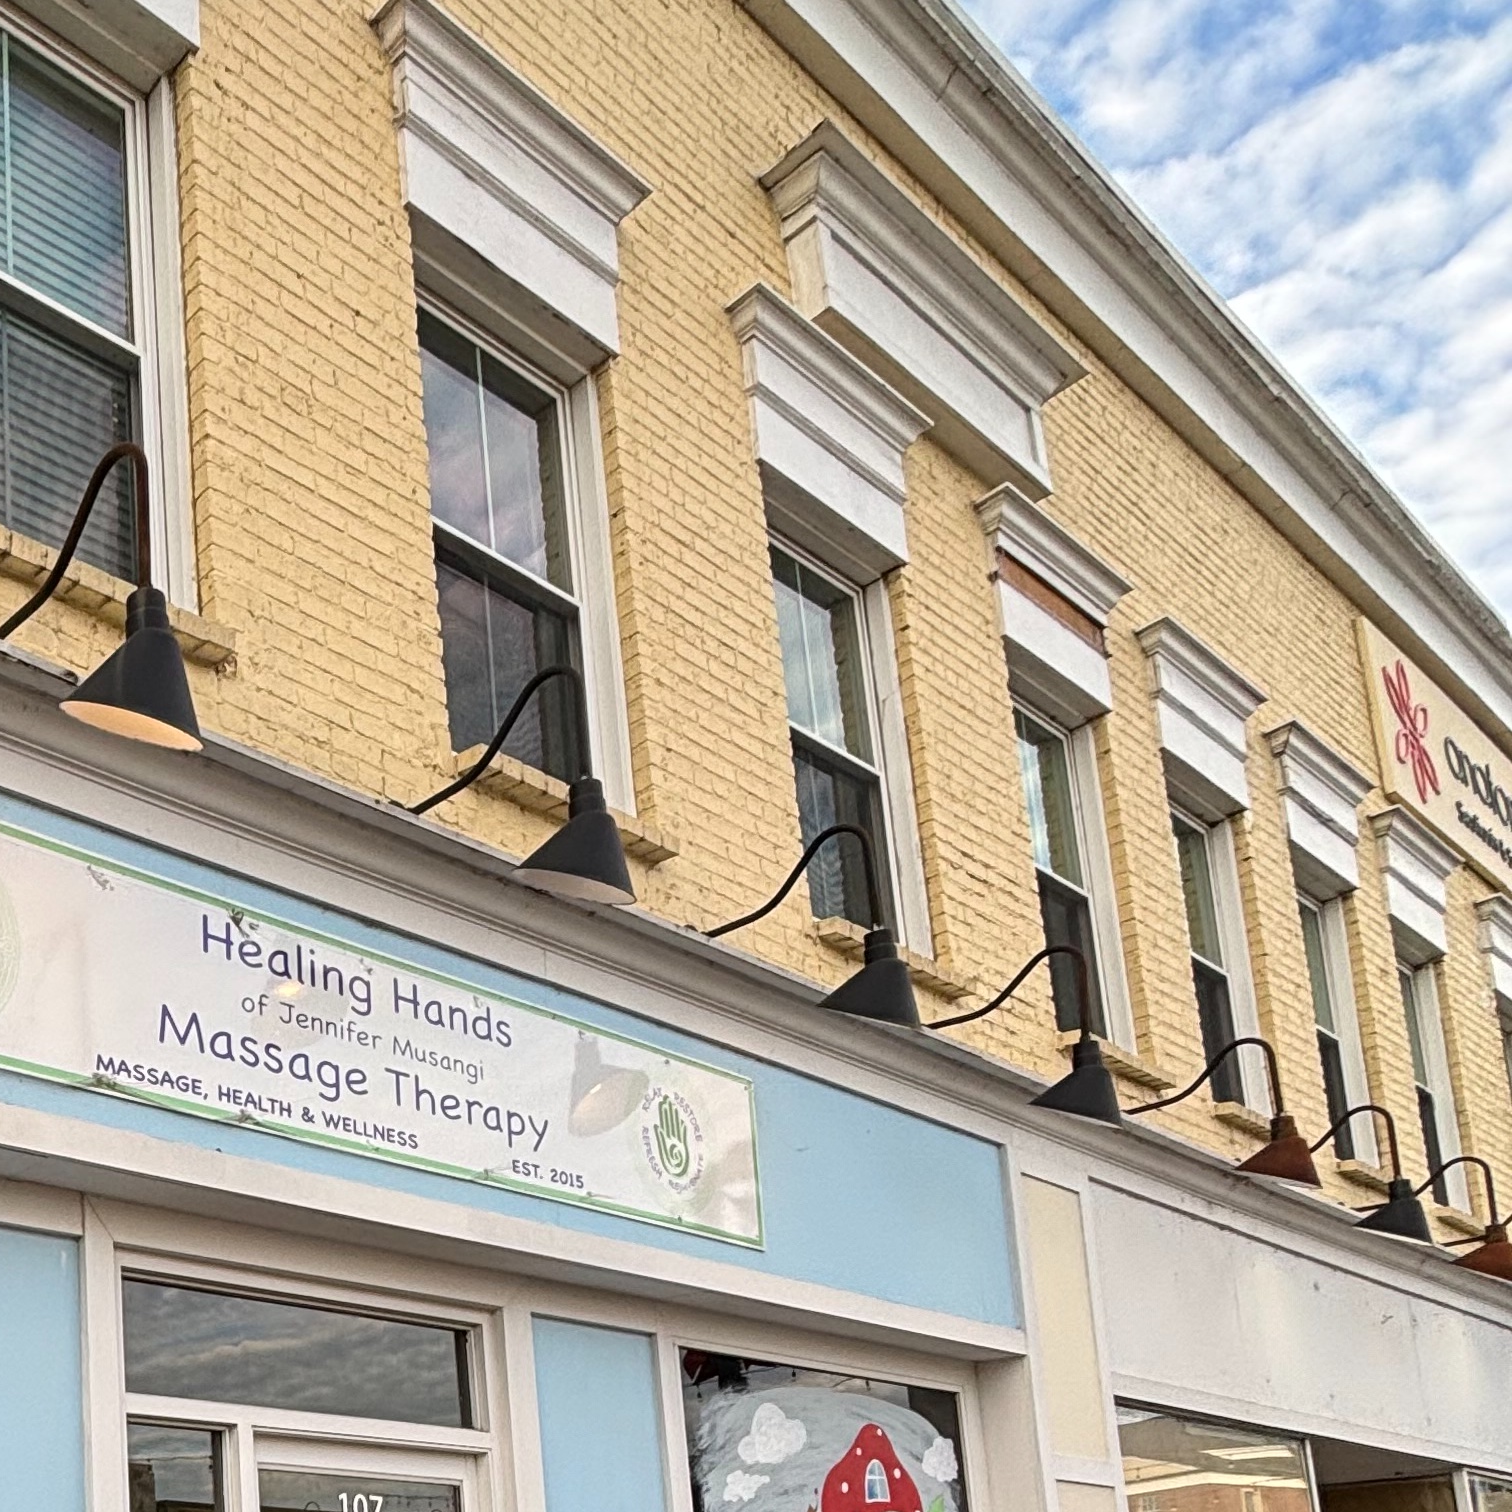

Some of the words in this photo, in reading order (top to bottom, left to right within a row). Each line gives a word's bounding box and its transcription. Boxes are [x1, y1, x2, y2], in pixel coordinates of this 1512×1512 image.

[202, 913, 372, 1017] Healing
[393, 977, 512, 1048] Hands
[159, 1003, 369, 1102] Massage
[384, 1067, 549, 1152] Therapy
[241, 993, 269, 1016] of
[278, 1000, 383, 1049] Jennifer
[392, 1035, 484, 1085] Musangi
[95, 1053, 209, 1101] MASSAGE,
[218, 1084, 292, 1119] HEALTH
[301, 1106, 316, 1123] &
[321, 1110, 419, 1150] WELLNESS
[673, 1091, 703, 1142] RESTORE
[511, 1159, 544, 1180] EST.
[550, 1168, 584, 1189] 2015
